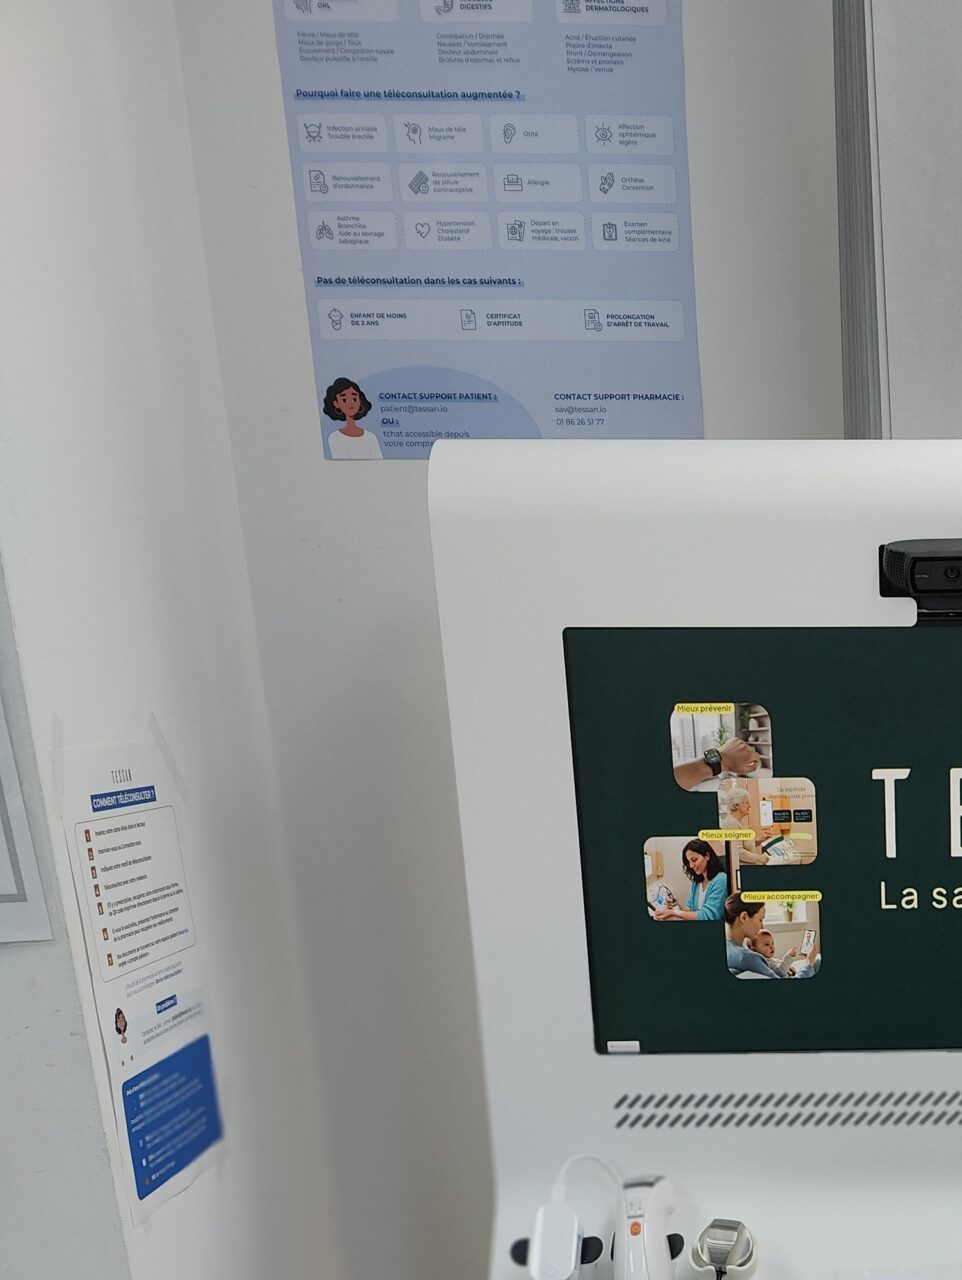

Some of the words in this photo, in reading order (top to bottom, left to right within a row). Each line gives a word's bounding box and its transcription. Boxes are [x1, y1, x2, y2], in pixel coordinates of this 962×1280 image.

[585, 5, 649, 13] DERMATOLOGIQUES
[296, 88, 338, 99] Pourquoi
[340, 88, 360, 98] faire
[383, 89, 458, 98] téléconsultation
[460, 90, 513, 100] augmentée
[618, 131, 656, 139] ophtalmique
[527, 179, 550, 187] Allergie
[624, 228, 672, 236] complémentaire
[316, 276, 332, 285] Pas
[334, 276, 347, 284] de
[348, 276, 422, 285] téléconsultation
[424, 276, 446, 285] dans
[447, 276, 461, 285] les
[479, 277, 516, 285] suivants
[379, 392, 418, 400] CONTACT
[380, 404, 448, 414] patient@tessan.io
[555, 406, 606, 414] sav@tessan.io
[445, 430, 470, 439] depuis
[700, 704, 732, 713] prévenir
[93, 795, 117, 808] COMMENT
[117, 790, 150, 804] TÉLÉCONSULTER
[724, 832, 751, 840] soigner
[767, 893, 819, 902] accompagner
[880, 881, 918, 910] La
